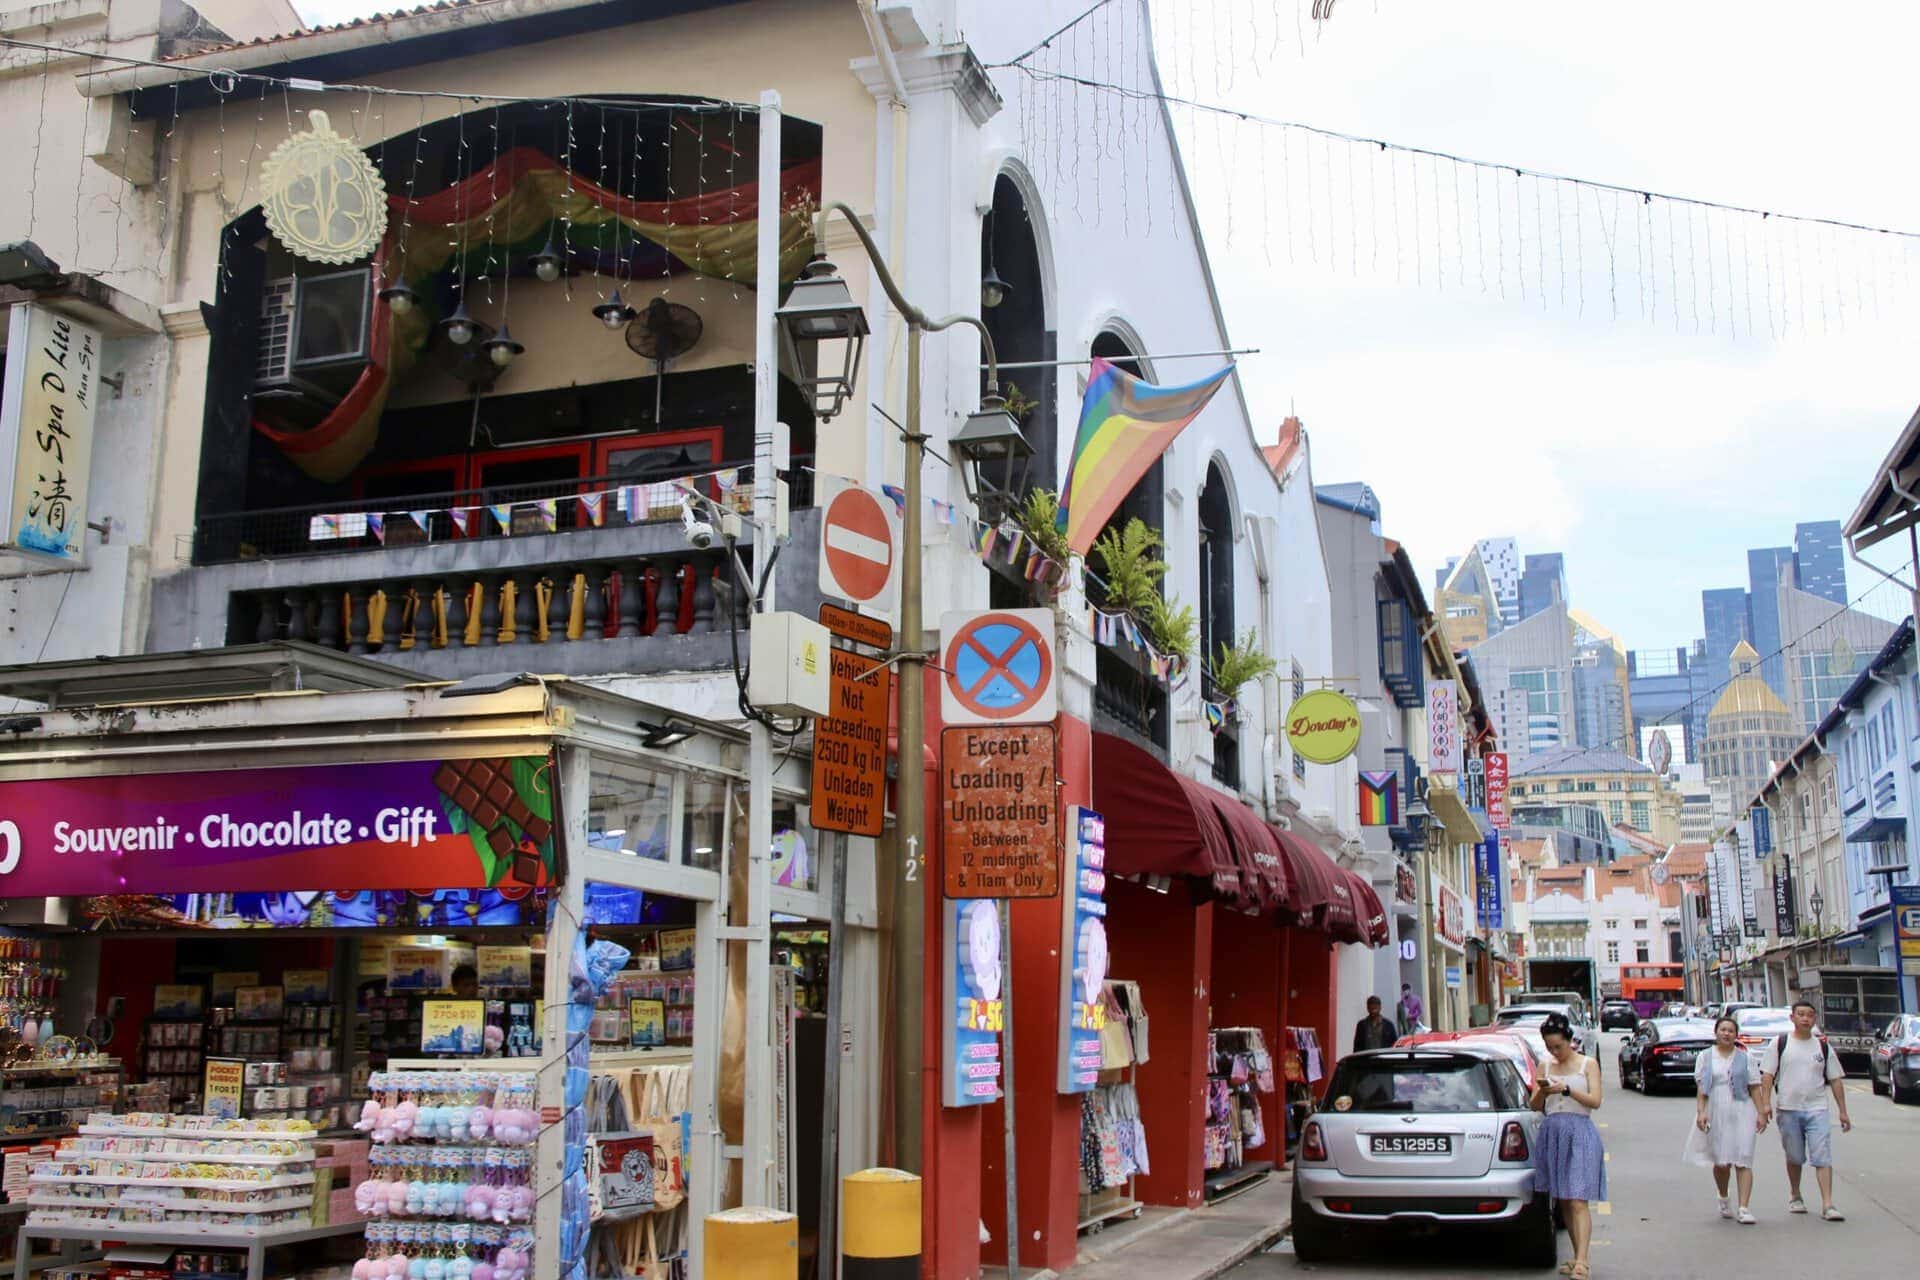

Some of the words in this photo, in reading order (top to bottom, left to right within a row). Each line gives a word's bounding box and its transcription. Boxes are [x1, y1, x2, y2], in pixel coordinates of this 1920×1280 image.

[43, 320, 71, 370] Lite
[36, 403, 71, 464] Spa
[830, 654, 880, 687] Vehicles
[840, 686, 865, 711] Not
[821, 718, 881, 748] Exceeding
[967, 734, 1030, 760] Except
[817, 738, 849, 765] 2500
[853, 750, 867, 775] kg
[823, 767, 874, 798] Unladen
[951, 767, 1024, 793] Loading
[1038, 766, 1047, 787] /
[826, 798, 869, 829] Weight
[951, 800, 1048, 826] Unloading
[54, 816, 179, 853] Souvenir
[200, 810, 352, 848] Chocolate
[375, 806, 437, 848] Gift
[972, 832, 1028, 847] Between
[962, 853, 974, 867] 12
[982, 851, 1040, 869] midnight
[958, 873, 967, 888] &
[976, 872, 1006, 887] 11am
[1014, 872, 1044, 890] Only
[1839, 1037, 1875, 1048] TOYO
